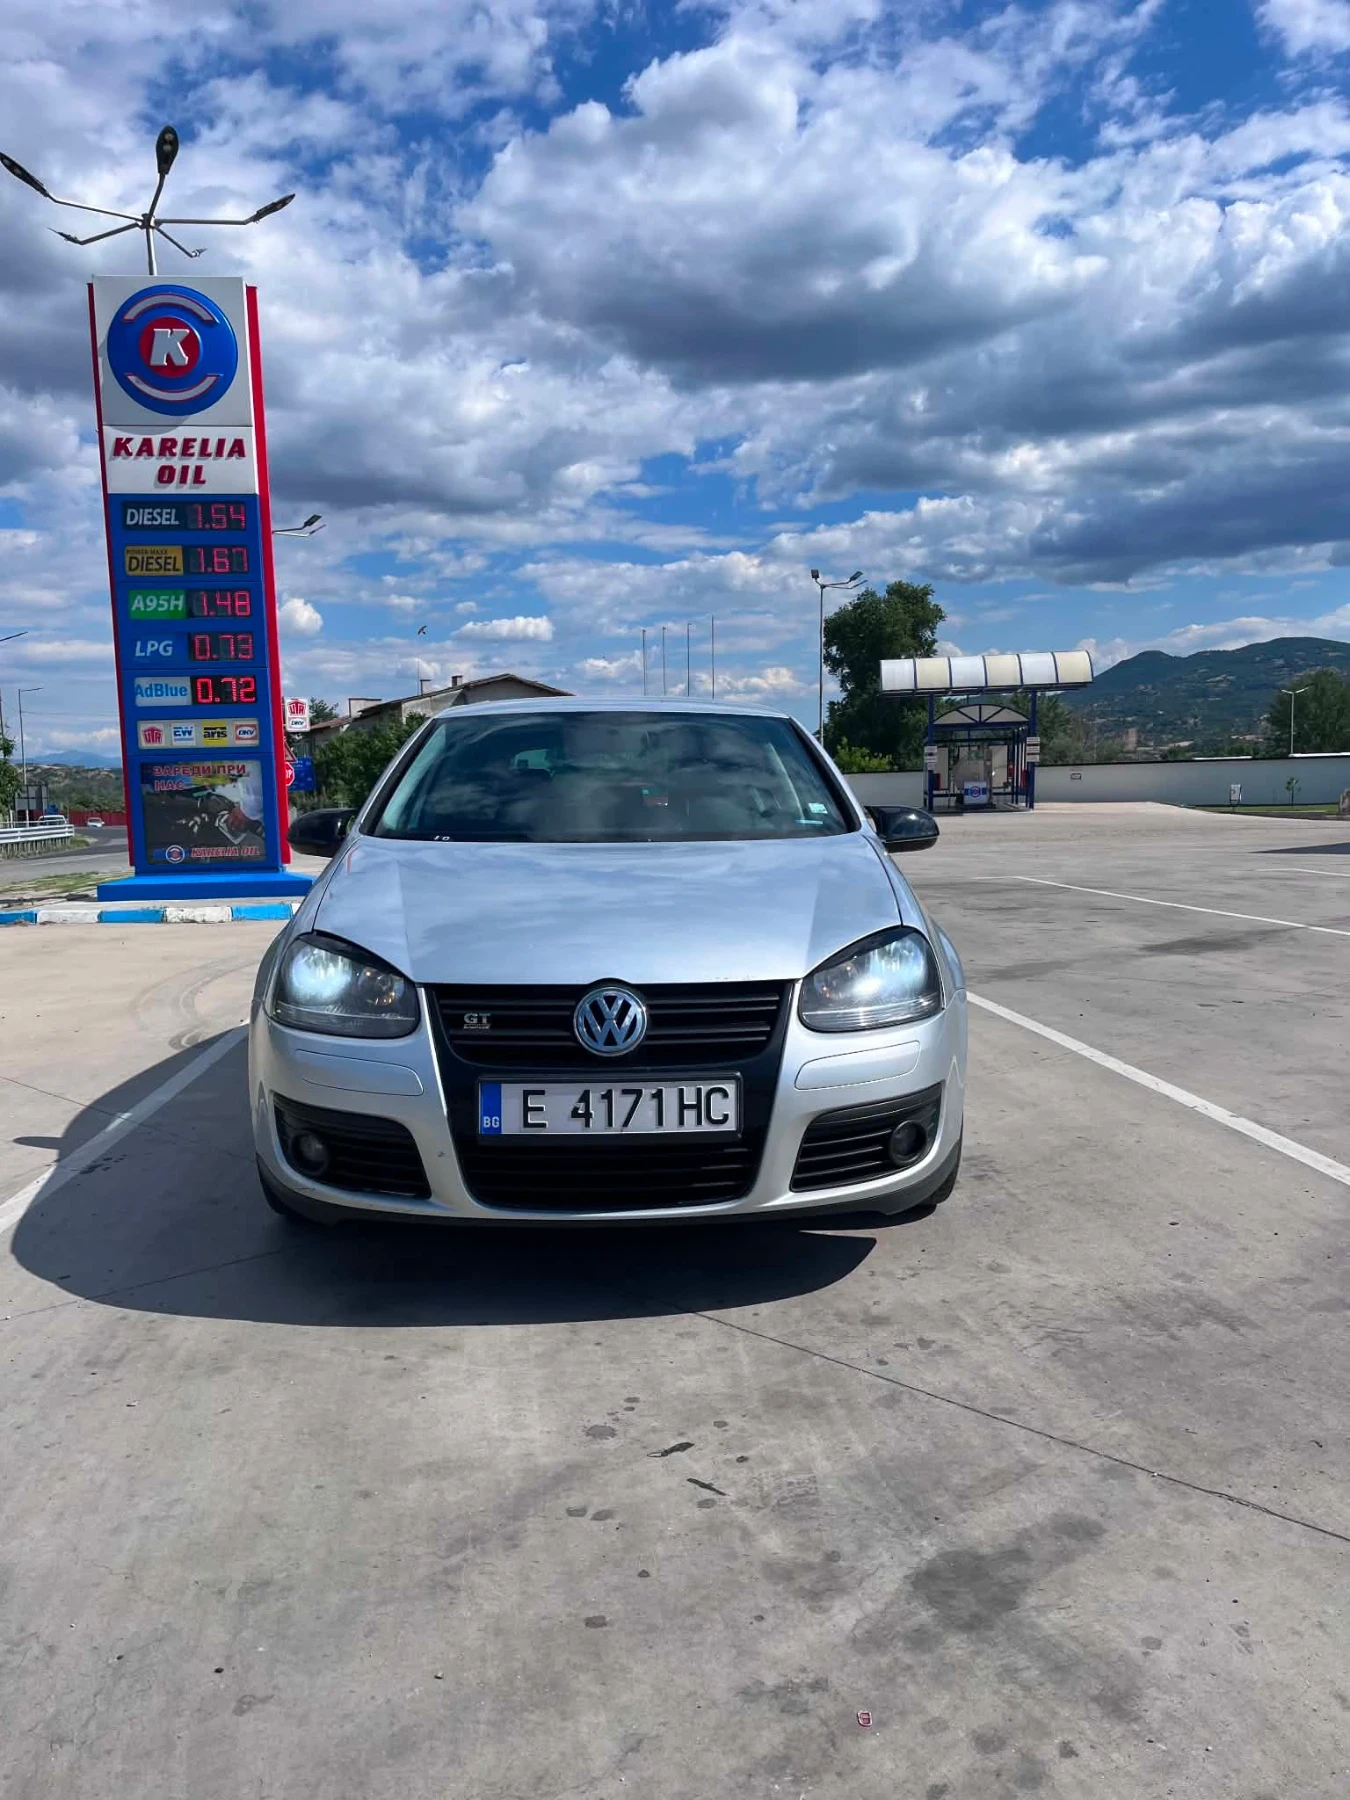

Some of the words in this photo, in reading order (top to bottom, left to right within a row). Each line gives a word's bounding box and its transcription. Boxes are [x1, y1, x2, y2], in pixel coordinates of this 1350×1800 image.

[150, 327, 190, 367] K
[113, 437, 246, 458] KARELIA
[156, 465, 207, 485] OIL
[126, 508, 179, 525] DIESEL
[196, 503, 246, 529] 1.54
[128, 556, 181, 572] DIESEL
[197, 547, 248, 573] 1.67
[131, 595, 185, 611] A95H
[201, 590, 251, 616] 1.48
[135, 640, 173, 657] LPG
[194, 634, 253, 660] 0.73
[135, 683, 188, 698] AdBlue
[196, 677, 256, 703] 0.72
[153, 765, 211, 777] ЗАРЕДИ
[216, 764, 246, 774] ПРИ
[154, 780, 184, 791] НАС
[463, 1012, 491, 1024] GT
[483, 1116, 500, 1128] BG
[522, 1089, 548, 1129] E
